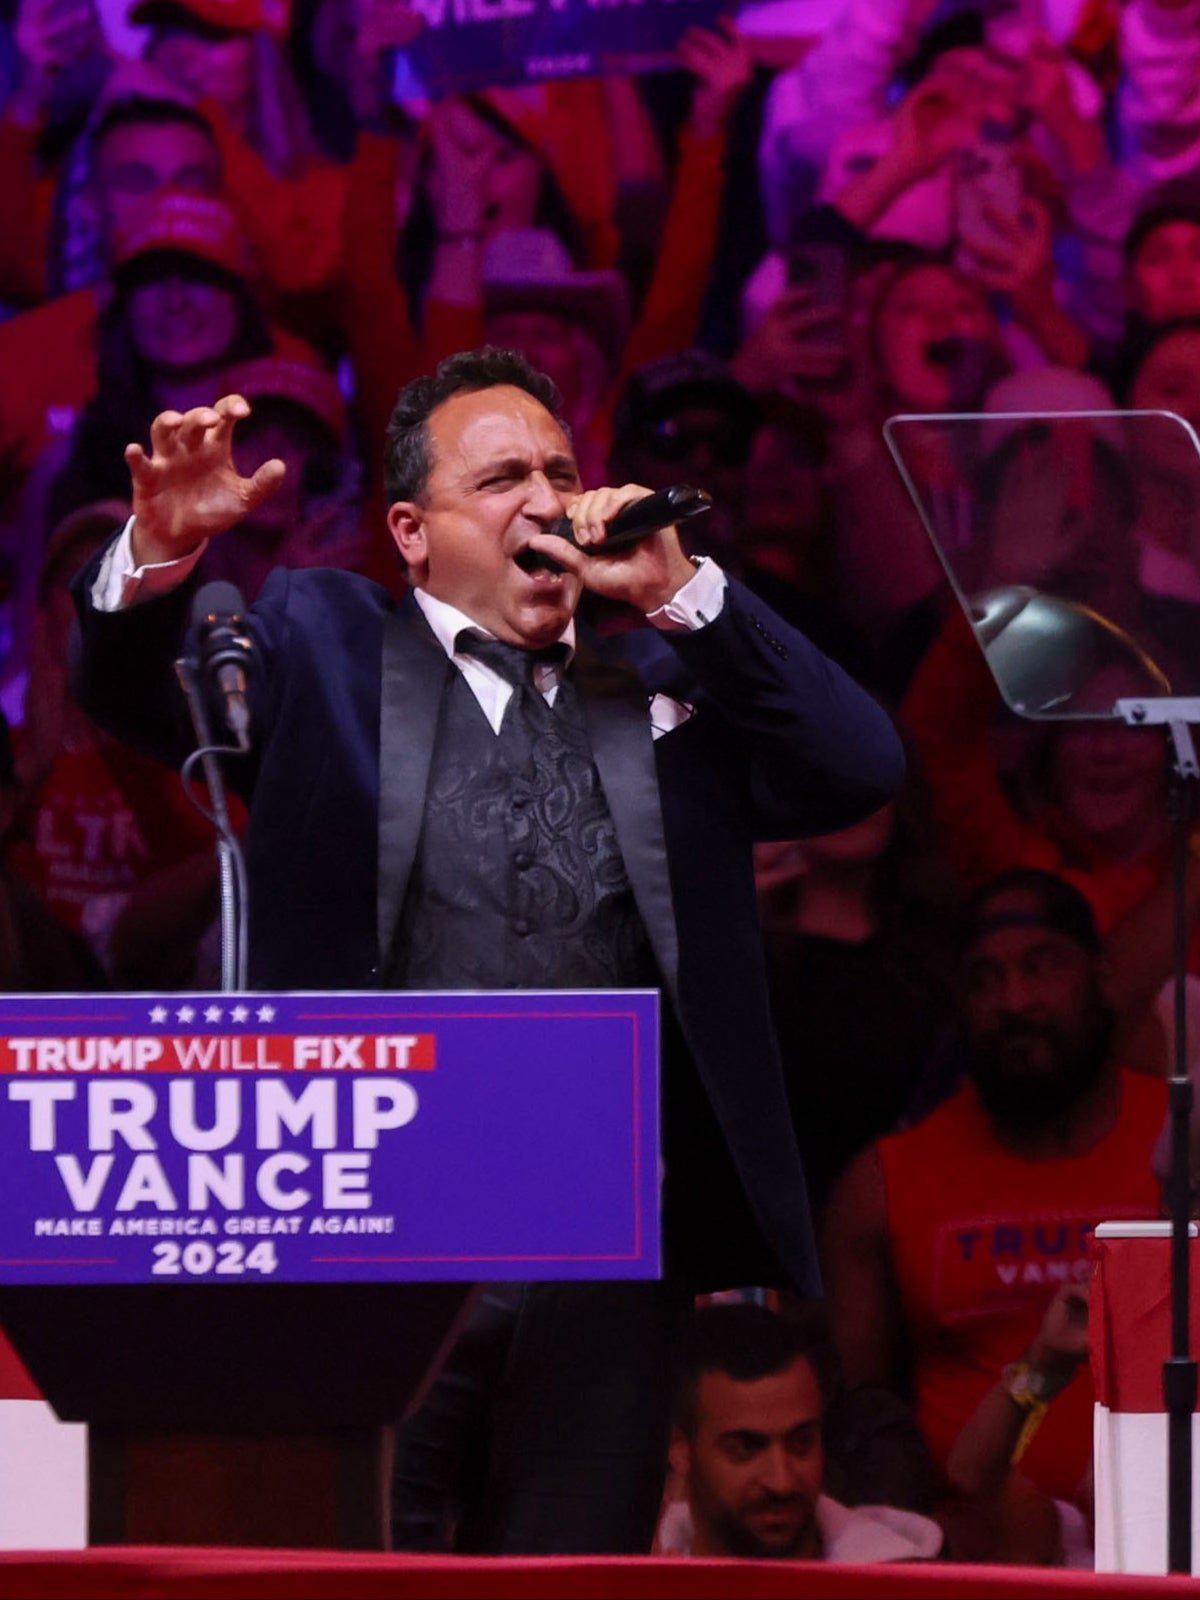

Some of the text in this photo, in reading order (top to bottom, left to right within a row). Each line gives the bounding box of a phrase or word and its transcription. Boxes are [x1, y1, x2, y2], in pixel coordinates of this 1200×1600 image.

[7, 1036, 418, 1072] TRUMP WILL FIX IT
[8, 1077, 419, 1152] TRUMP
[54, 1152, 373, 1212] VANCE
[34, 1215, 395, 1236] MAKE AMERICA GREAT AGAIN!
[151, 1240, 279, 1275] 2024
